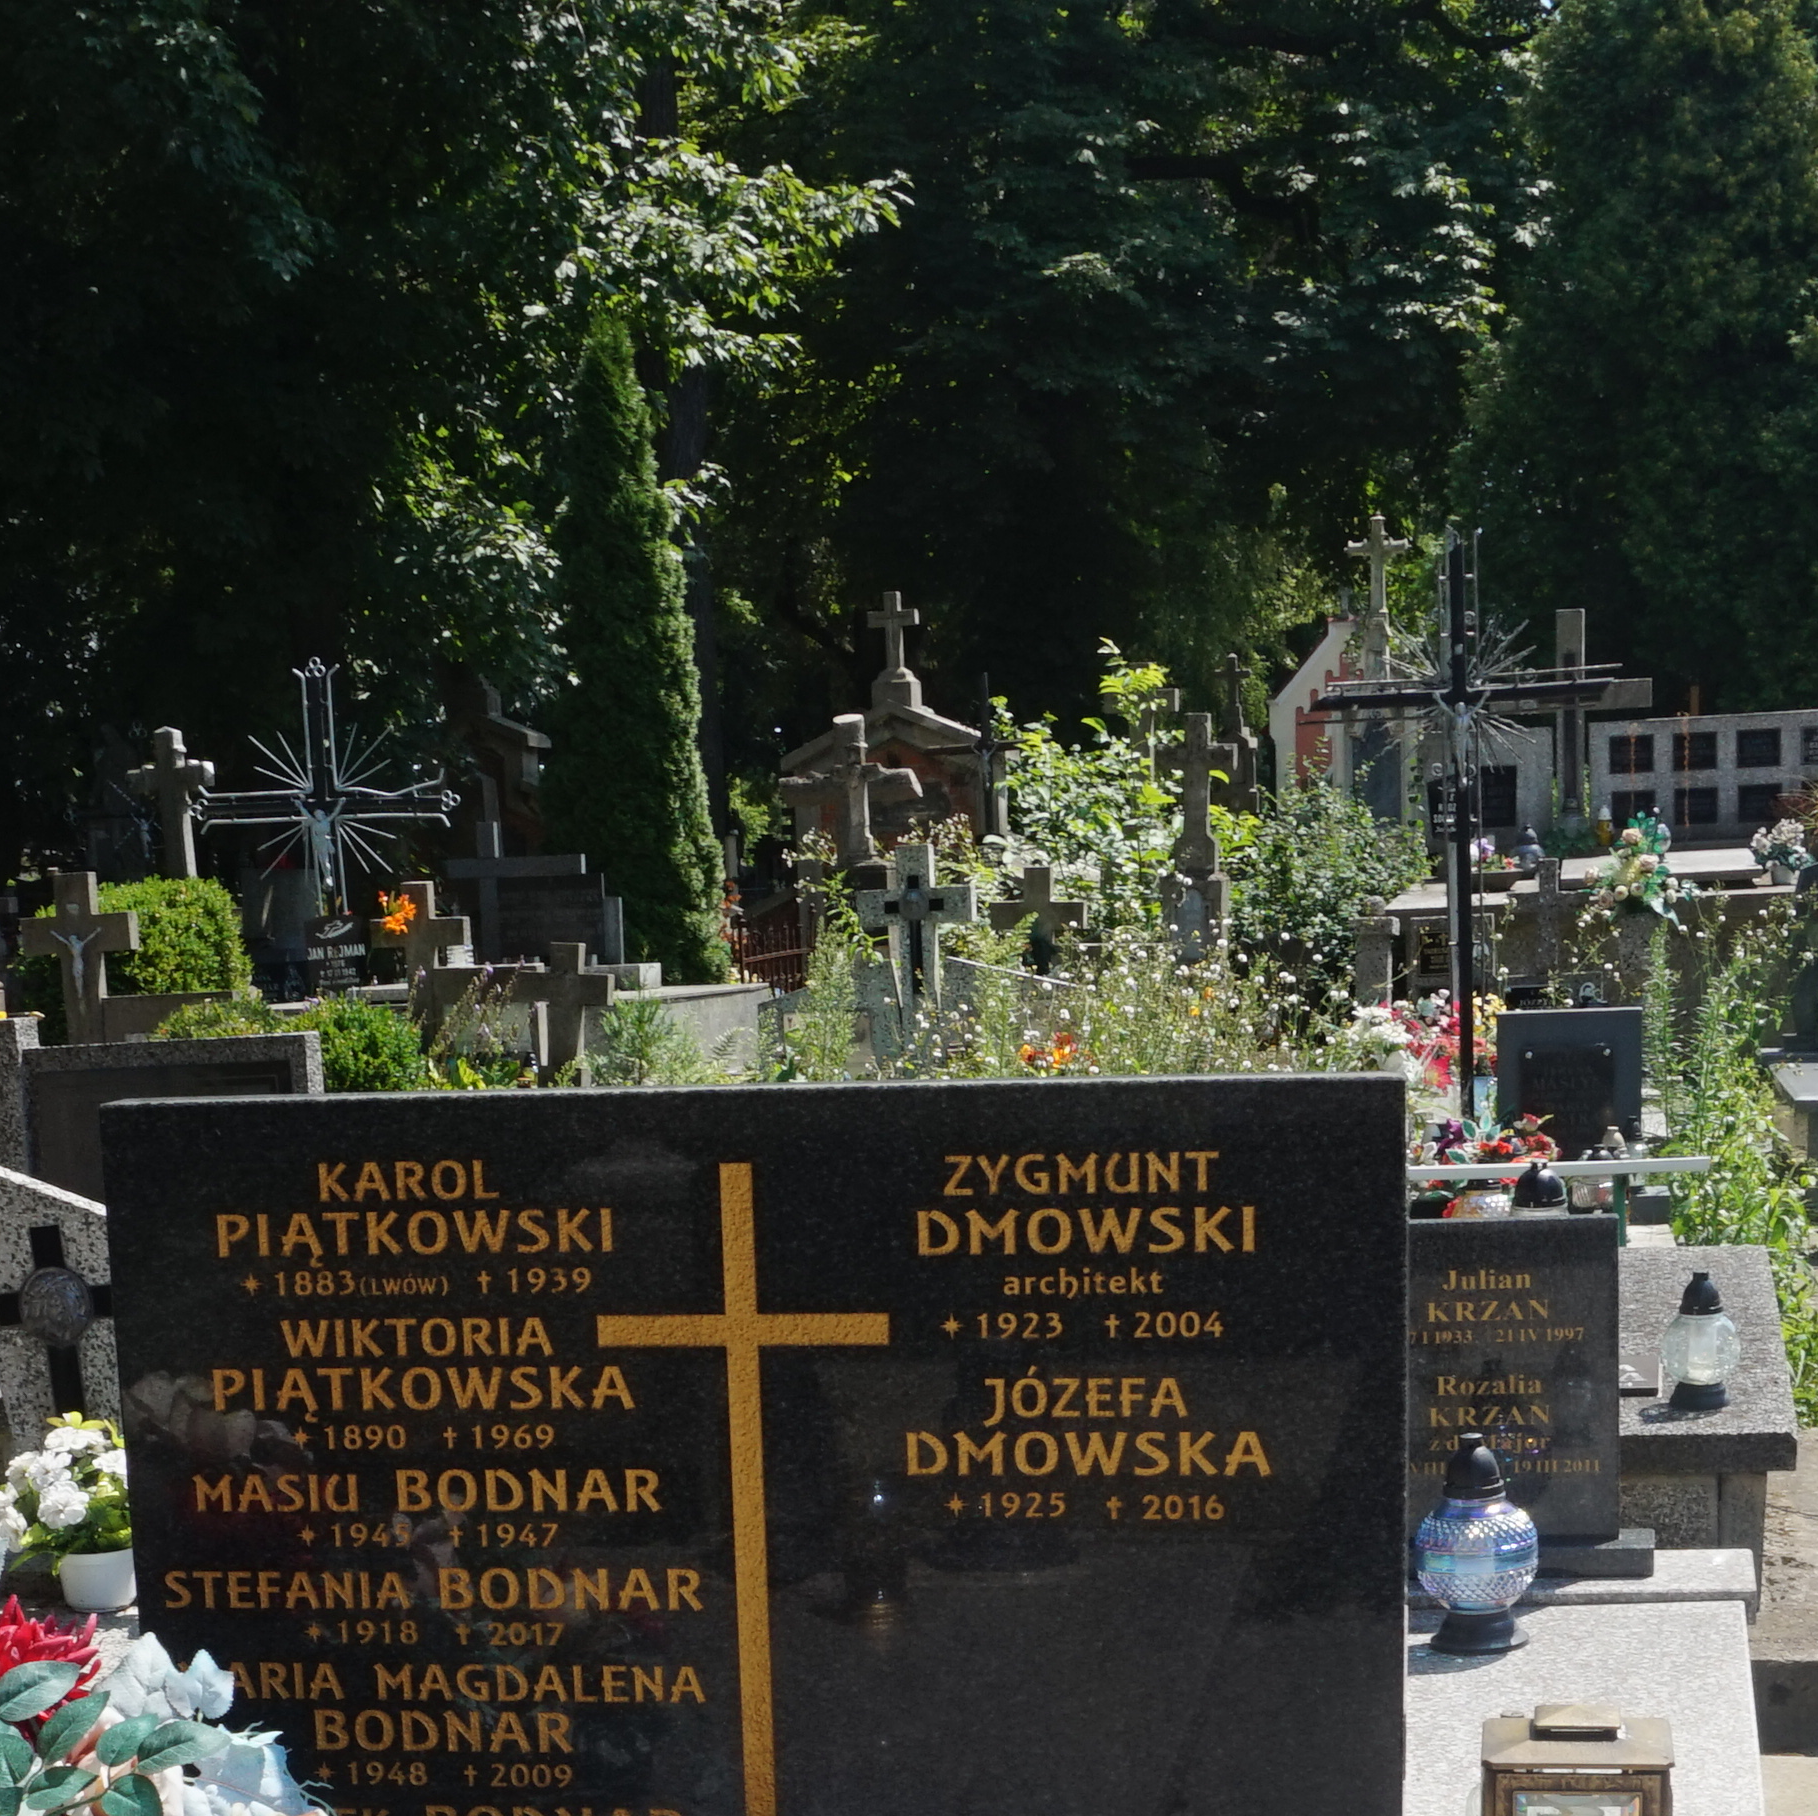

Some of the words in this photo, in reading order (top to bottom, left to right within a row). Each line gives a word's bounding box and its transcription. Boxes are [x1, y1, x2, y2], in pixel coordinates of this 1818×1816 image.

[307, 945, 325, 961] JAN
[317, 1159, 501, 1202] KAROL
[943, 1150, 1221, 1198] ZYGMUNT
[216, 1207, 614, 1267] PIĄTKOWSKI
[916, 1205, 1257, 1257] DMOWSKI
[507, 1266, 592, 1295] 1939
[1003, 1268, 1164, 1300] architekt
[1442, 1268, 1532, 1292] Julian
[977, 1311, 1065, 1340] 1923
[1133, 1311, 1225, 1340] 2004
[1427, 1299, 1550, 1324] KRZAN
[281, 1316, 554, 1358] WIKTORIA
[1434, 1330, 1474, 1345] 1933
[1545, 1326, 1585, 1342] 1997
[212, 1365, 637, 1423] PIĄTKOWSKA
[983, 1366, 1189, 1428] JÓZEFA
[1436, 1374, 1543, 1397] Rozalia
[1430, 1404, 1551, 1428] KRZAN
[324, 1425, 408, 1451] 1890
[472, 1424, 555, 1451] 1969
[905, 1430, 1275, 1479] DMOWSKA
[1513, 1460, 1531, 1475] 19
[192, 1473, 360, 1514] MASIU
[396, 1468, 664, 1514] BODNAR
[980, 1491, 1067, 1519] 1925
[1142, 1494, 1225, 1521] 2016
[330, 1522, 412, 1549] 1945
[478, 1522, 559, 1549] 1947
[163, 1570, 412, 1610] STEFANIA
[438, 1566, 706, 1612] BODNAR
[337, 1620, 420, 1646] 1918
[488, 1621, 566, 1648] 2017
[178, 1660, 345, 1702] ARIA
[375, 1665, 708, 1705] MAGDALENA
[314, 1709, 576, 1755] BODNAR
[347, 1761, 430, 1787] 1948
[489, 1763, 574, 1789] 2009
